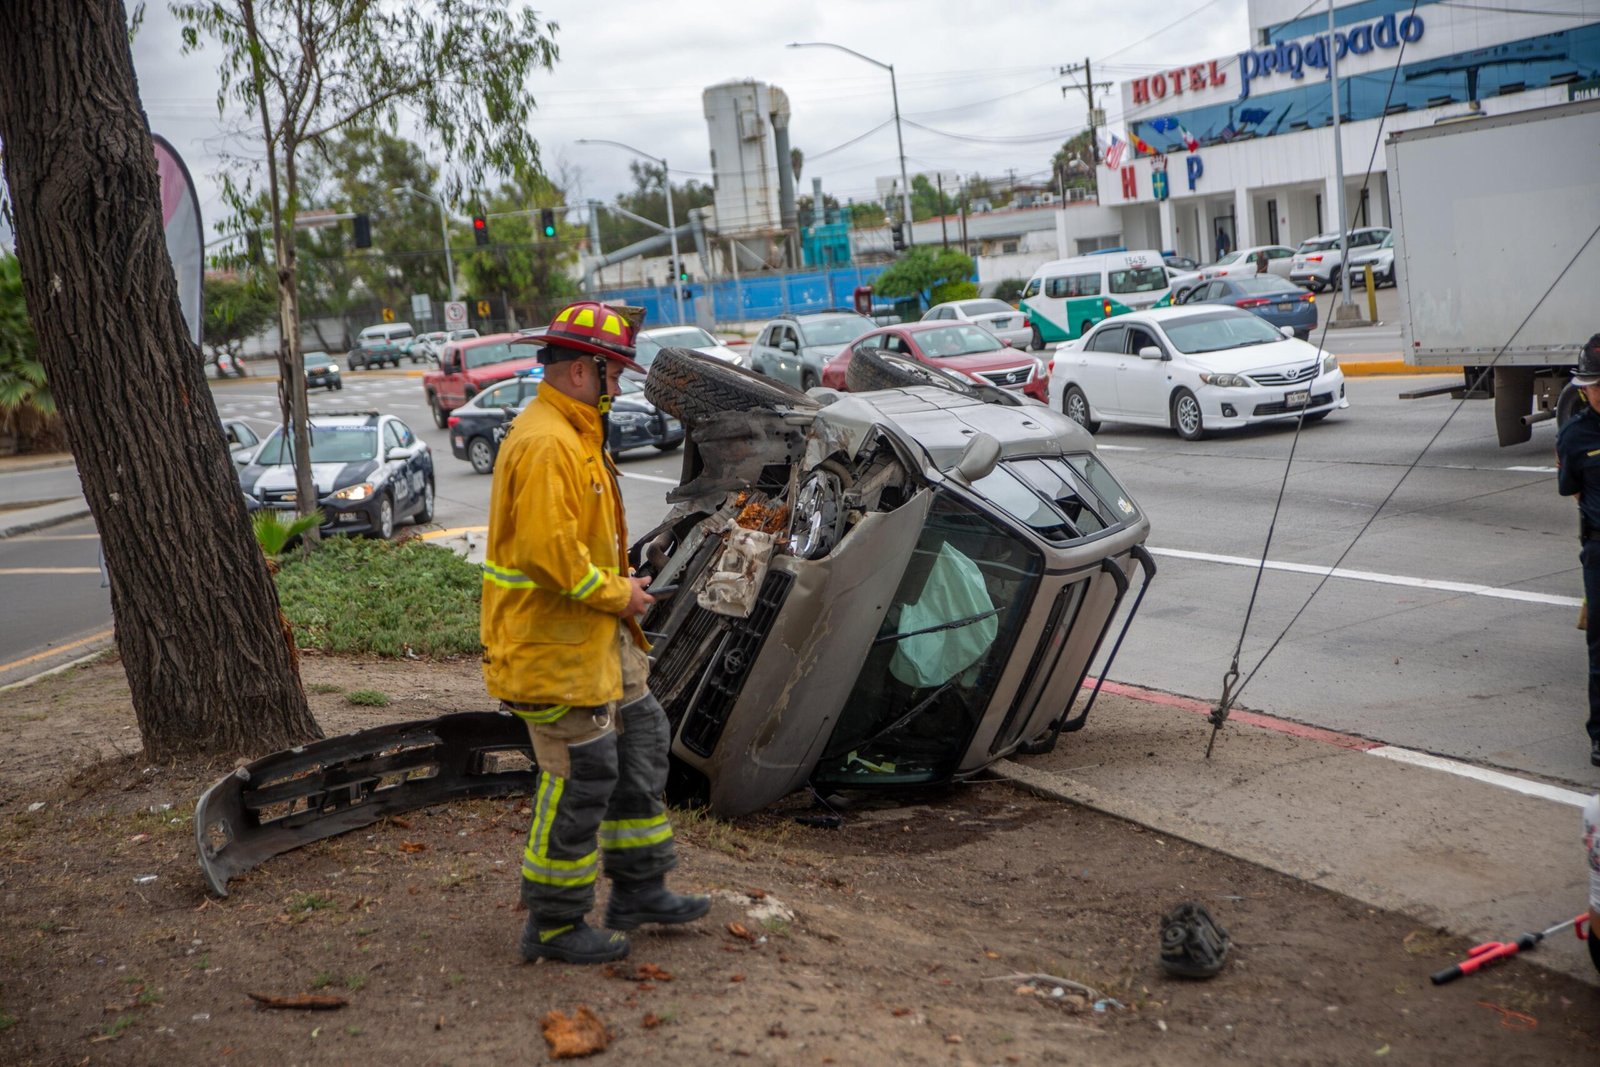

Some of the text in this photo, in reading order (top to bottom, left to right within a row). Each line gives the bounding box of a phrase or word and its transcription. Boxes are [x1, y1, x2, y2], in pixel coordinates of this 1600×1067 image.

[1132, 60, 1226, 104] HOTEL
[1121, 154, 1204, 199] H P
